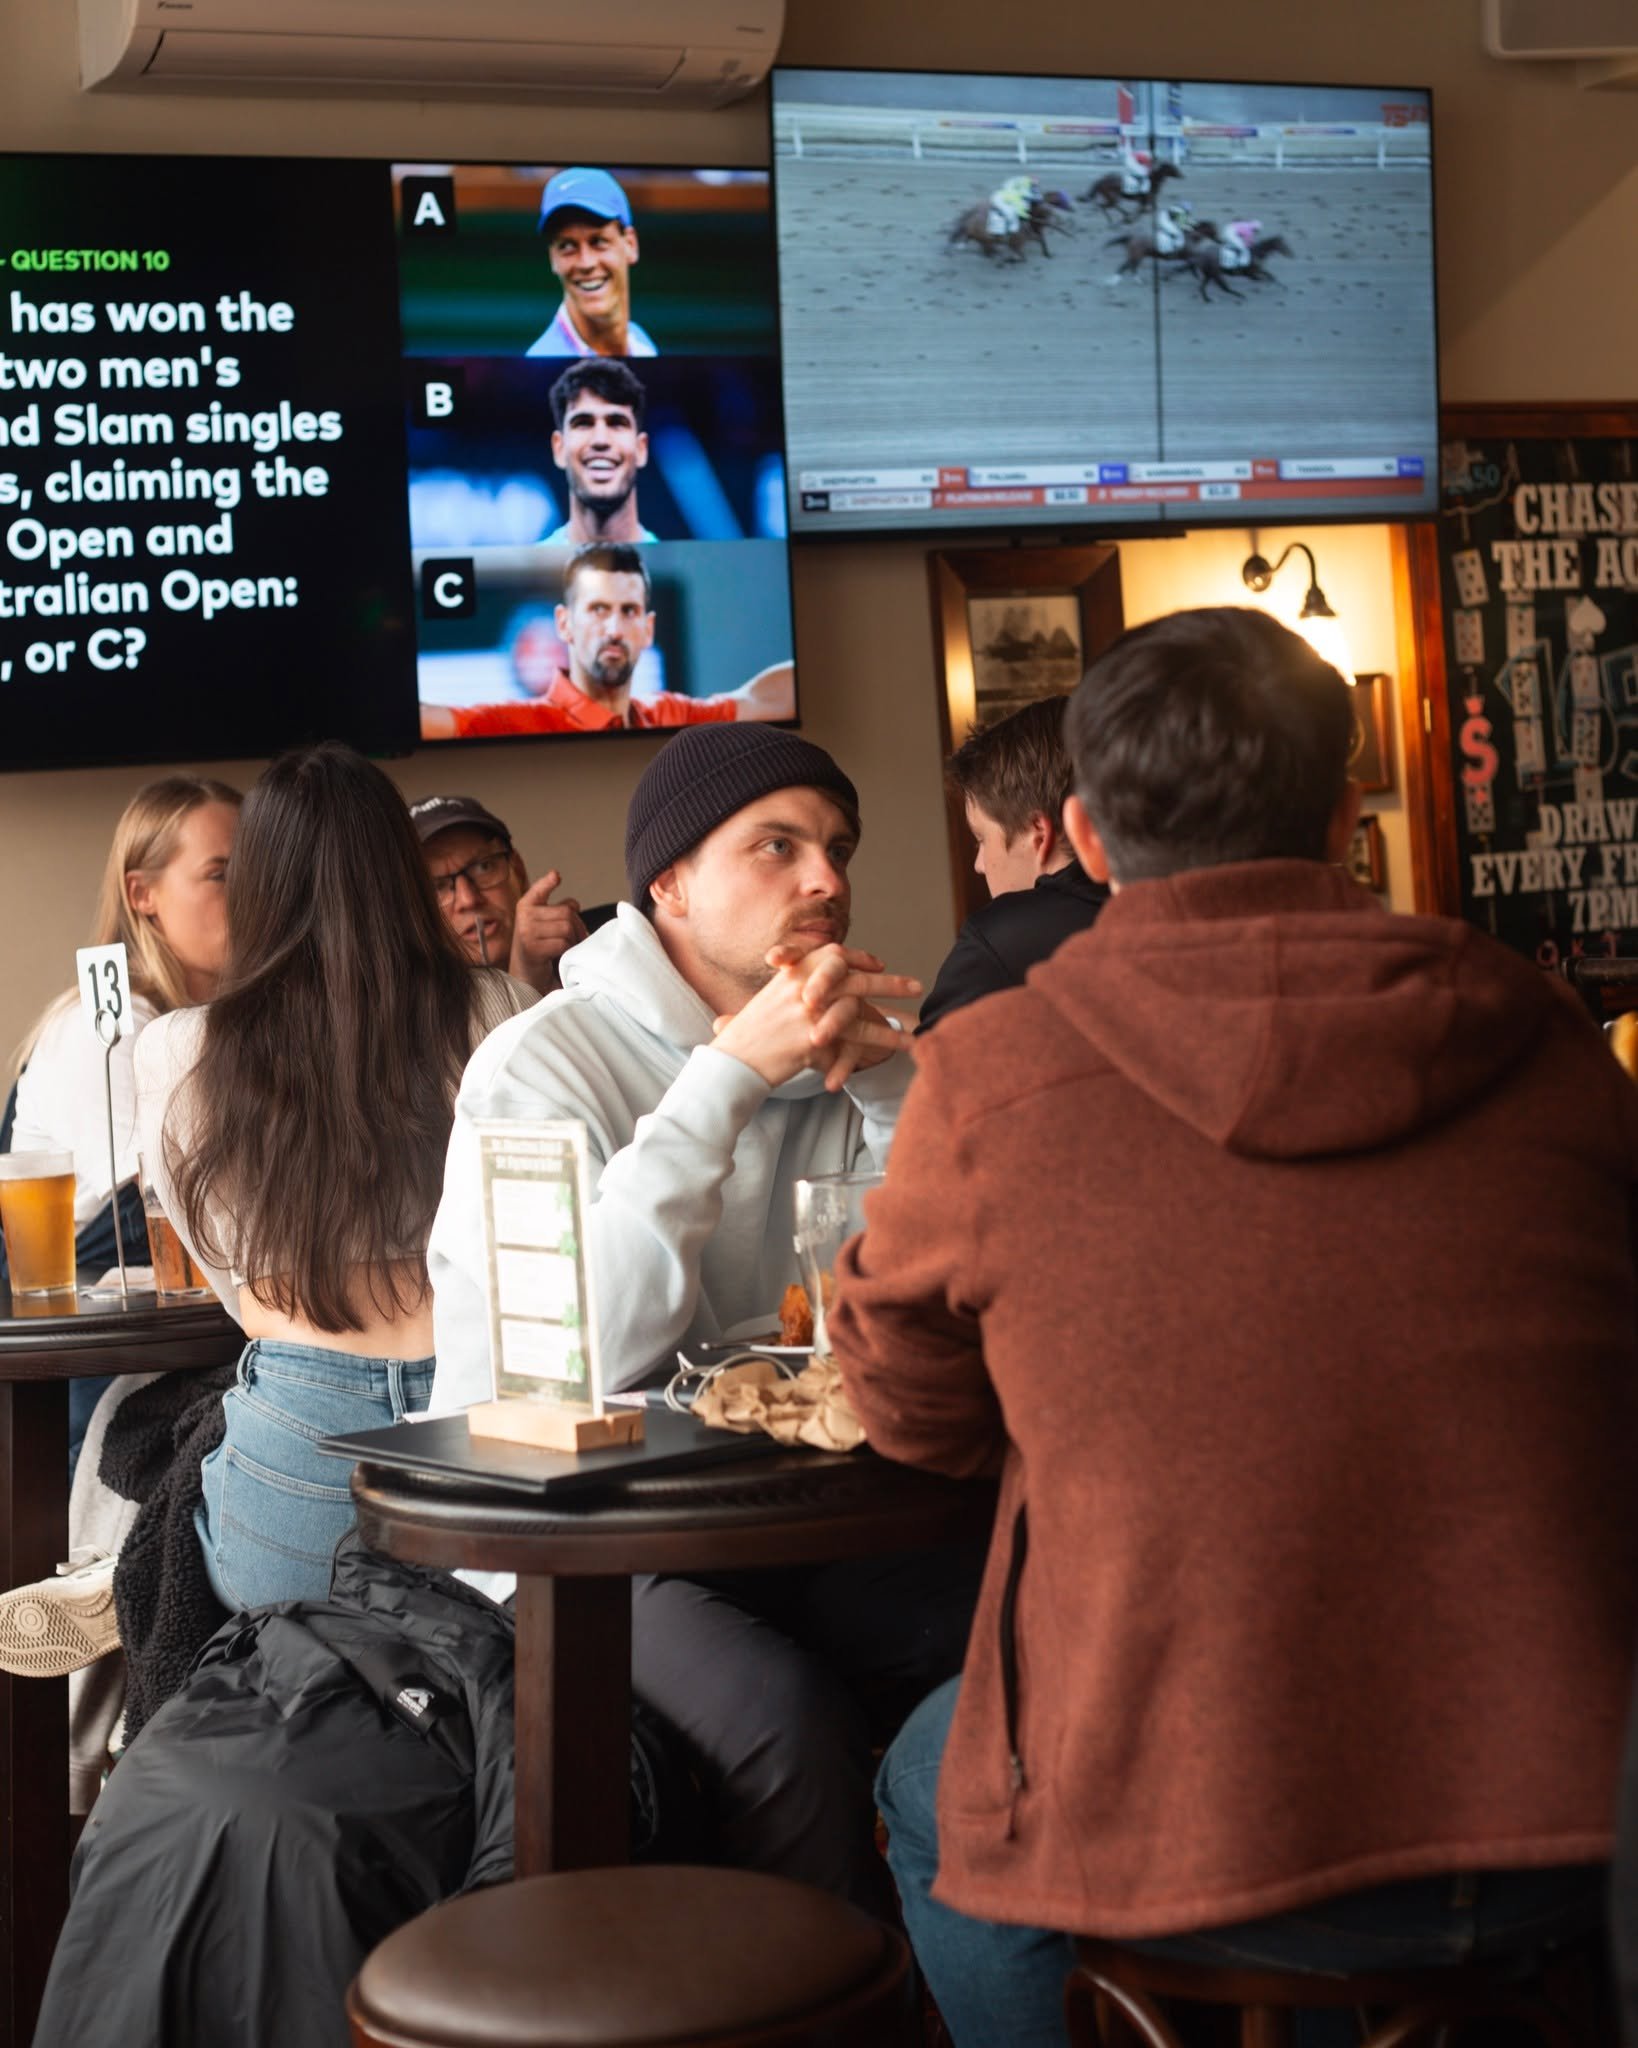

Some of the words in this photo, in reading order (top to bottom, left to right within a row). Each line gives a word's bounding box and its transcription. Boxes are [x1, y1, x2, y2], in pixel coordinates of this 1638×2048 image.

[415, 193, 444, 225] A
[11, 250, 138, 270] QUESTION
[143, 251, 169, 270] 10
[11, 291, 95, 333] has
[106, 302, 205, 332] won
[216, 291, 294, 332] the
[0, 352, 87, 389] two
[100, 346, 240, 388] men's
[426, 383, 452, 416] B
[54, 403, 173, 445] Slam
[186, 401, 342, 452] singles
[45, 457, 241, 508] claiming
[251, 456, 329, 497] the
[7, 518, 133, 569] Open
[146, 512, 233, 556] and
[1491, 539, 1580, 590] THE
[161, 570, 298, 619] Open:
[435, 573, 462, 607] C
[25, 641, 75, 673] or
[88, 627, 146, 670] C?
[1470, 846, 1586, 897] EVERY
[88, 960, 123, 1020] 13
